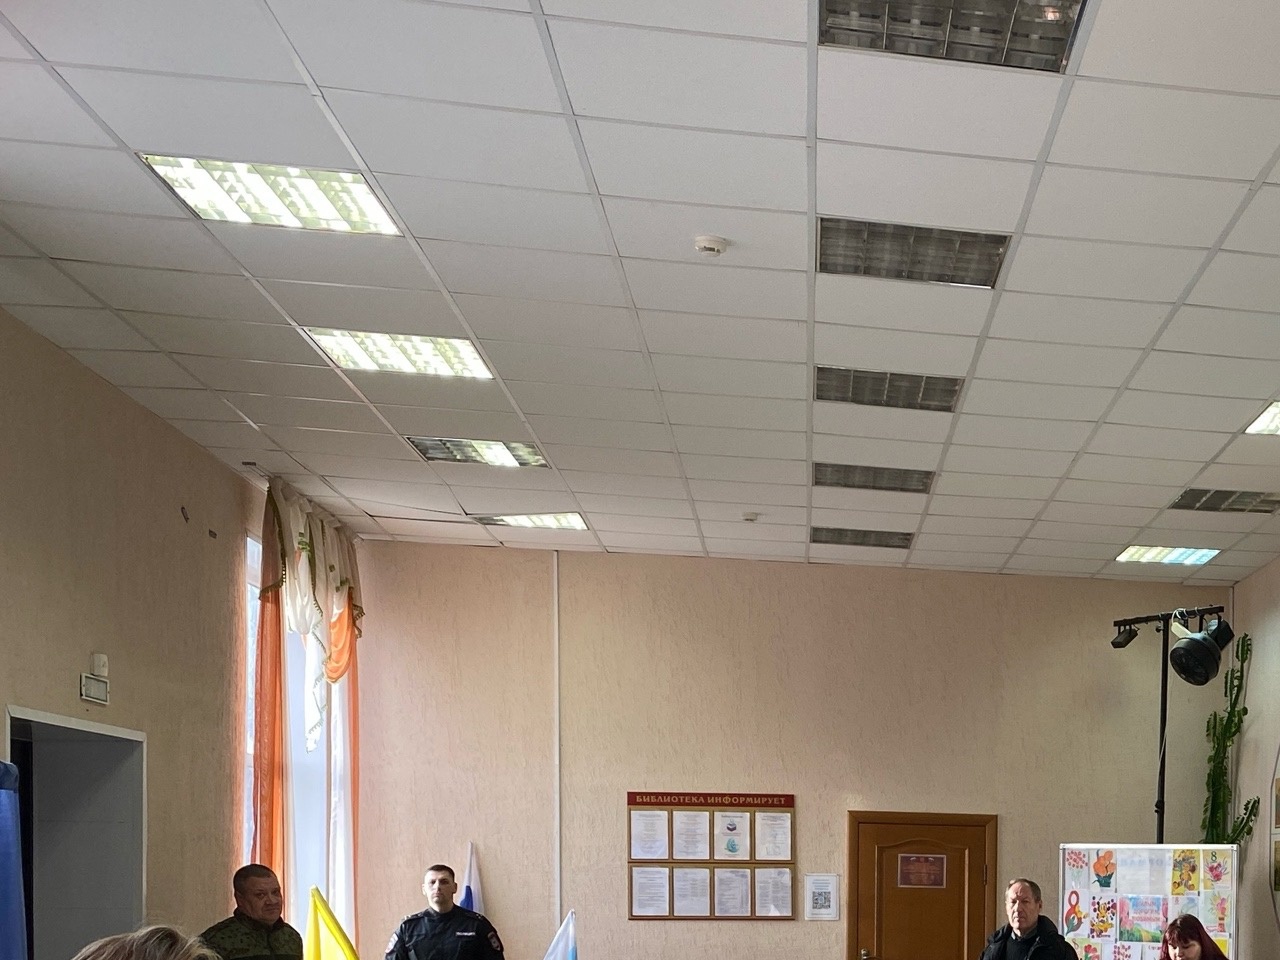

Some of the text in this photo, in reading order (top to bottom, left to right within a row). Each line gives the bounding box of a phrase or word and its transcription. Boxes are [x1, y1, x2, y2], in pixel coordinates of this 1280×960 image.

[636, 795, 785, 805] БИБЛИОТЕКА ИНФОРМИРУЕТ
[1210, 851, 1217, 861] 8
